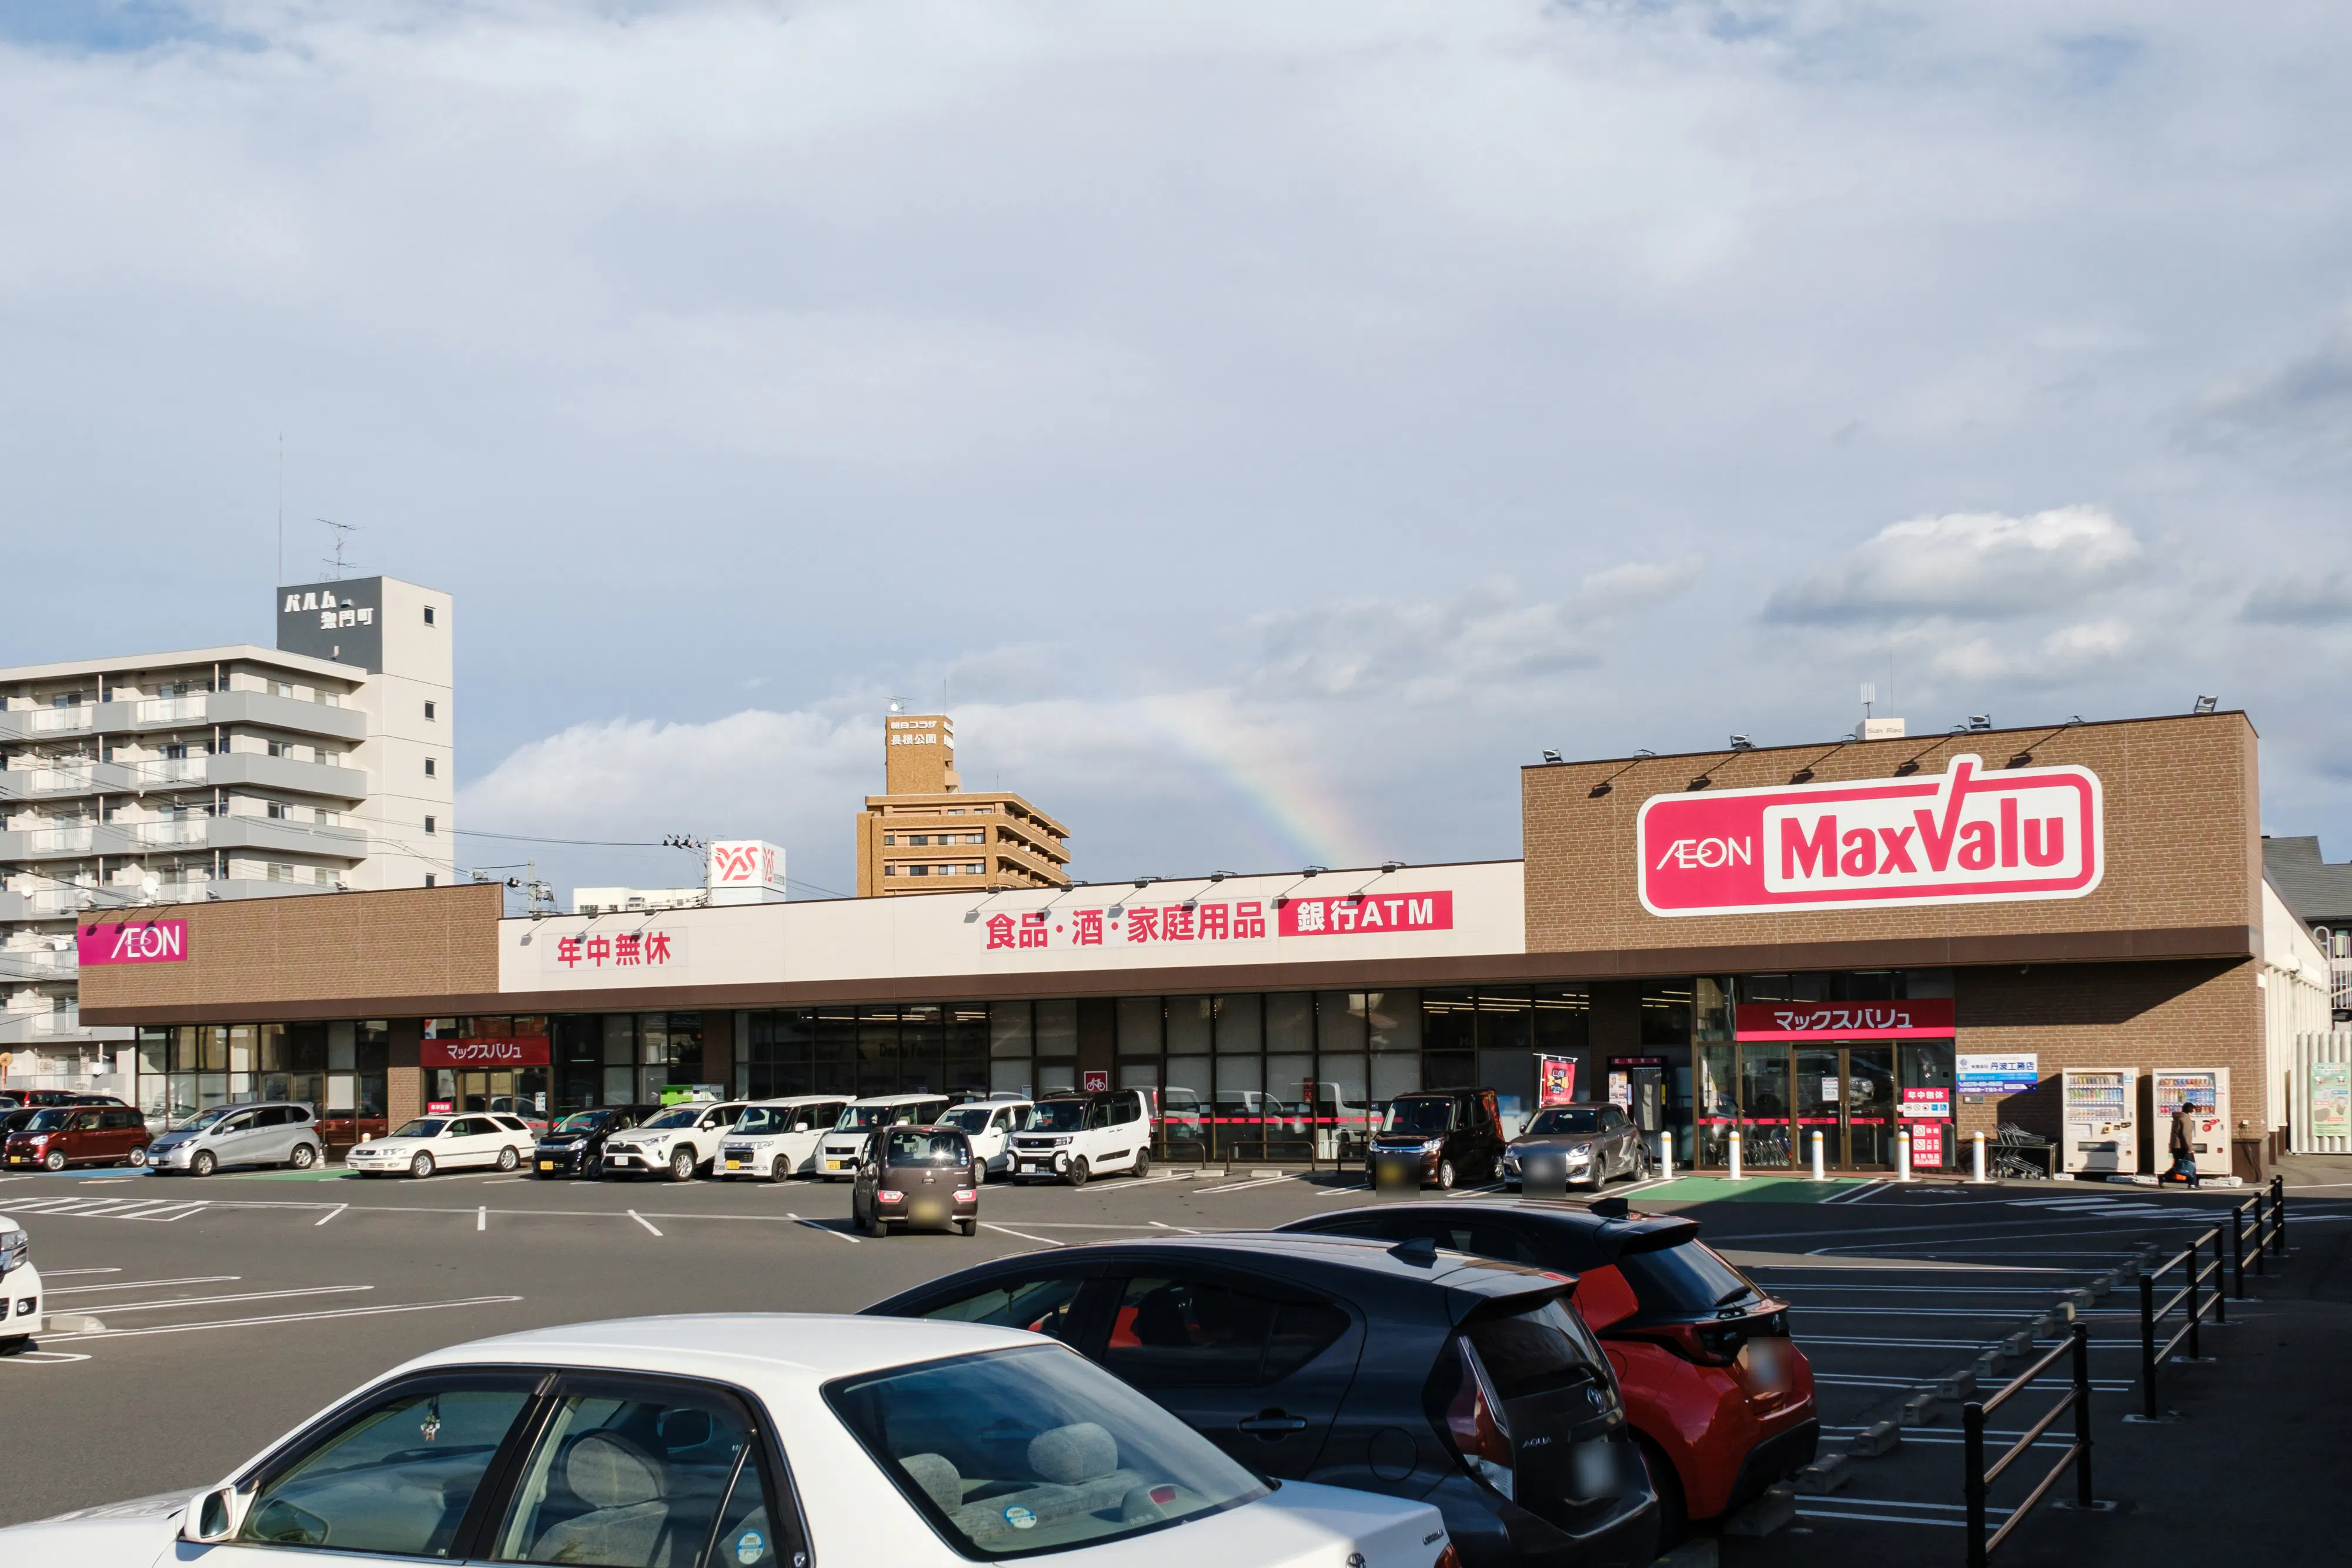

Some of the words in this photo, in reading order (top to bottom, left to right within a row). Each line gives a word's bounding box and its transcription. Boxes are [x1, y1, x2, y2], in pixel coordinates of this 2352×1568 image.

[285, 591, 337, 613] パルム
[891, 734, 937, 745] 長根公園
[1780, 763, 2064, 880] MaxValu
[1297, 897, 1434, 931] 銀行ATM
[985, 901, 1267, 951] 食品・酒・家庭用品
[557, 931, 671, 968] 年中無休
[1774, 1008, 1913, 1031] マックスバリュ
[447, 1043, 522, 1059] マックスバリュ
[1990, 1062, 2034, 1071] 丹波工務店
[1521, 1436, 1552, 1449] AQUA
